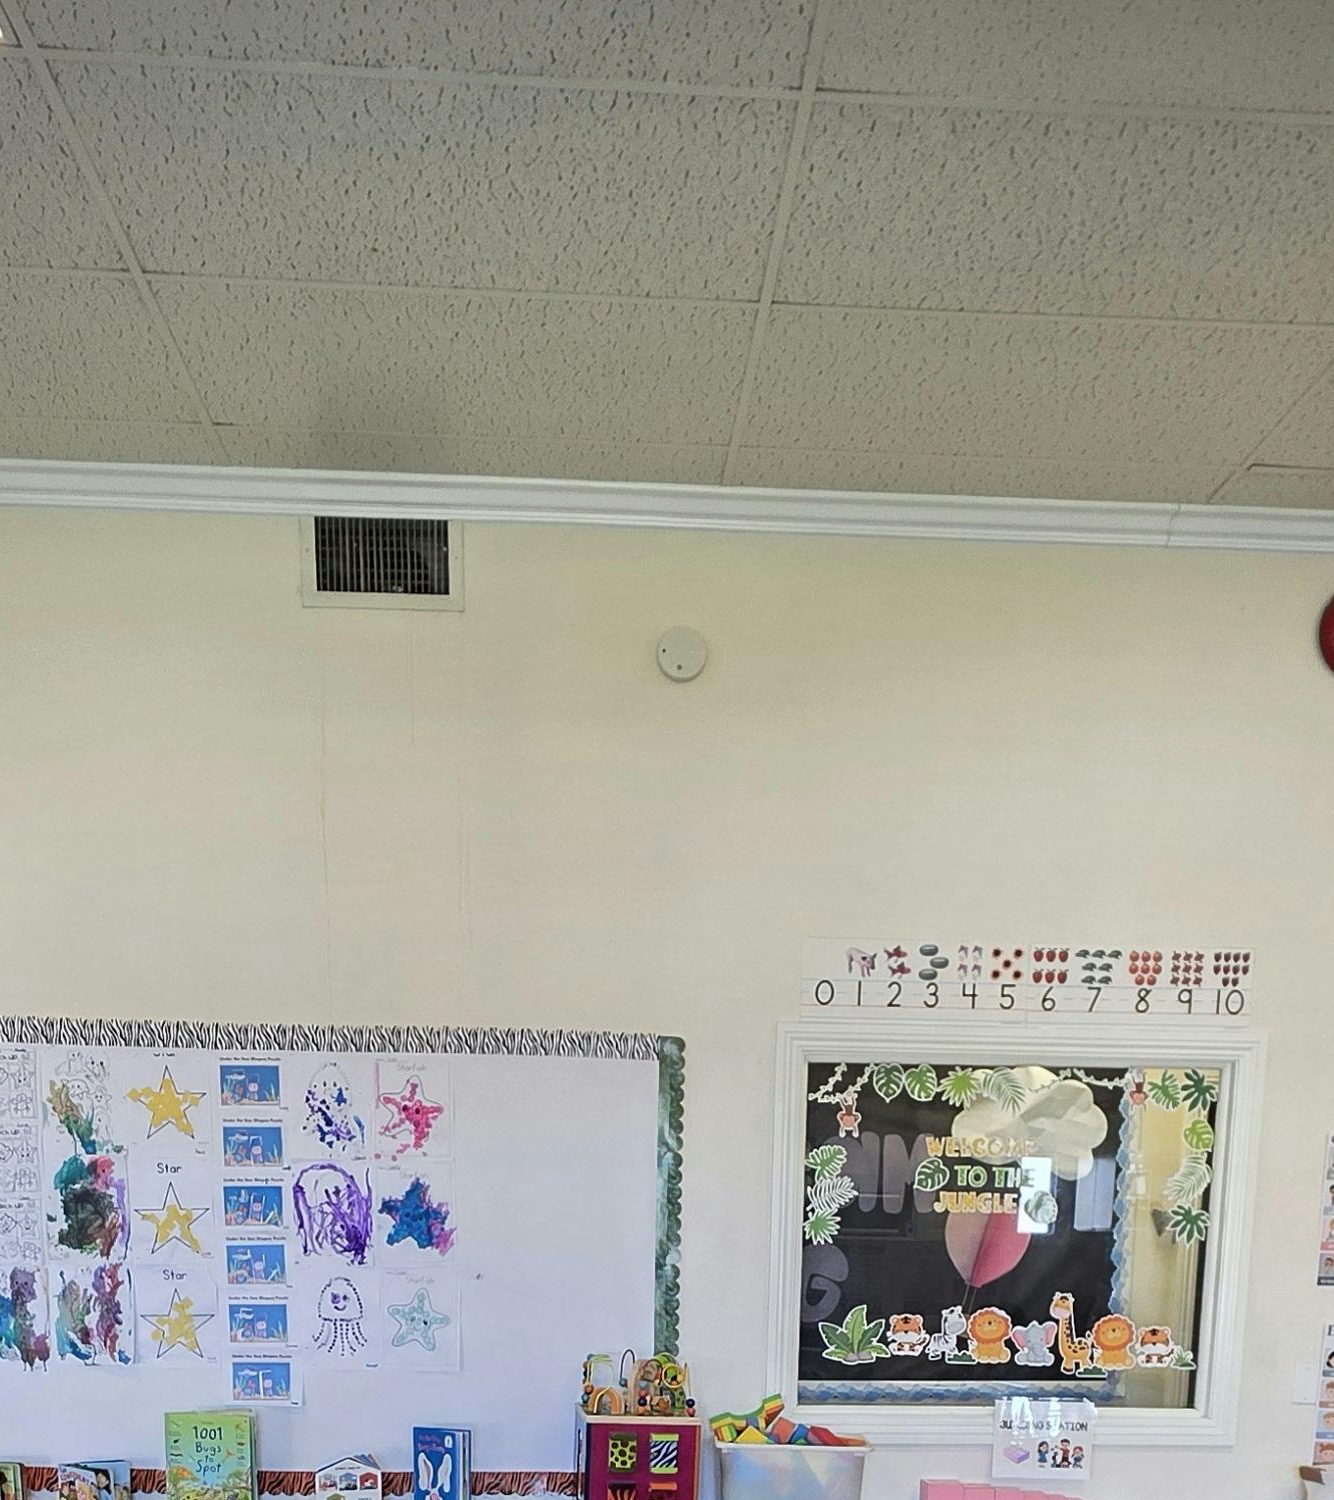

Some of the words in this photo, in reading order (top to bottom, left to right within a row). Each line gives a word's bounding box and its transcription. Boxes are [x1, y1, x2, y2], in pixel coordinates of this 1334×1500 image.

[815, 980, 834, 1005] 0
[856, 980, 863, 1007] 1
[887, 981, 902, 1007] 2
[923, 982, 939, 1008] 3
[962, 983, 978, 1009] 4
[999, 984, 1016, 1010] 5
[1041, 986, 1056, 1011] 6
[1087, 986, 1101, 1012] 7
[1135, 988, 1152, 1014] 8
[1178, 988, 1193, 1014] 9
[1216, 989, 1245, 1015] 10
[157, 1162, 182, 1174] Star
[954, 1165, 988, 1187] TO
[992, 1166, 1035, 1188] THE
[933, 1191, 1019, 1214] JUNGLE
[162, 1269, 187, 1281] Star
[192, 1426, 222, 1440] 1001
[195, 1441, 221, 1456] Bugs
[196, 1459, 221, 1477] Spot
